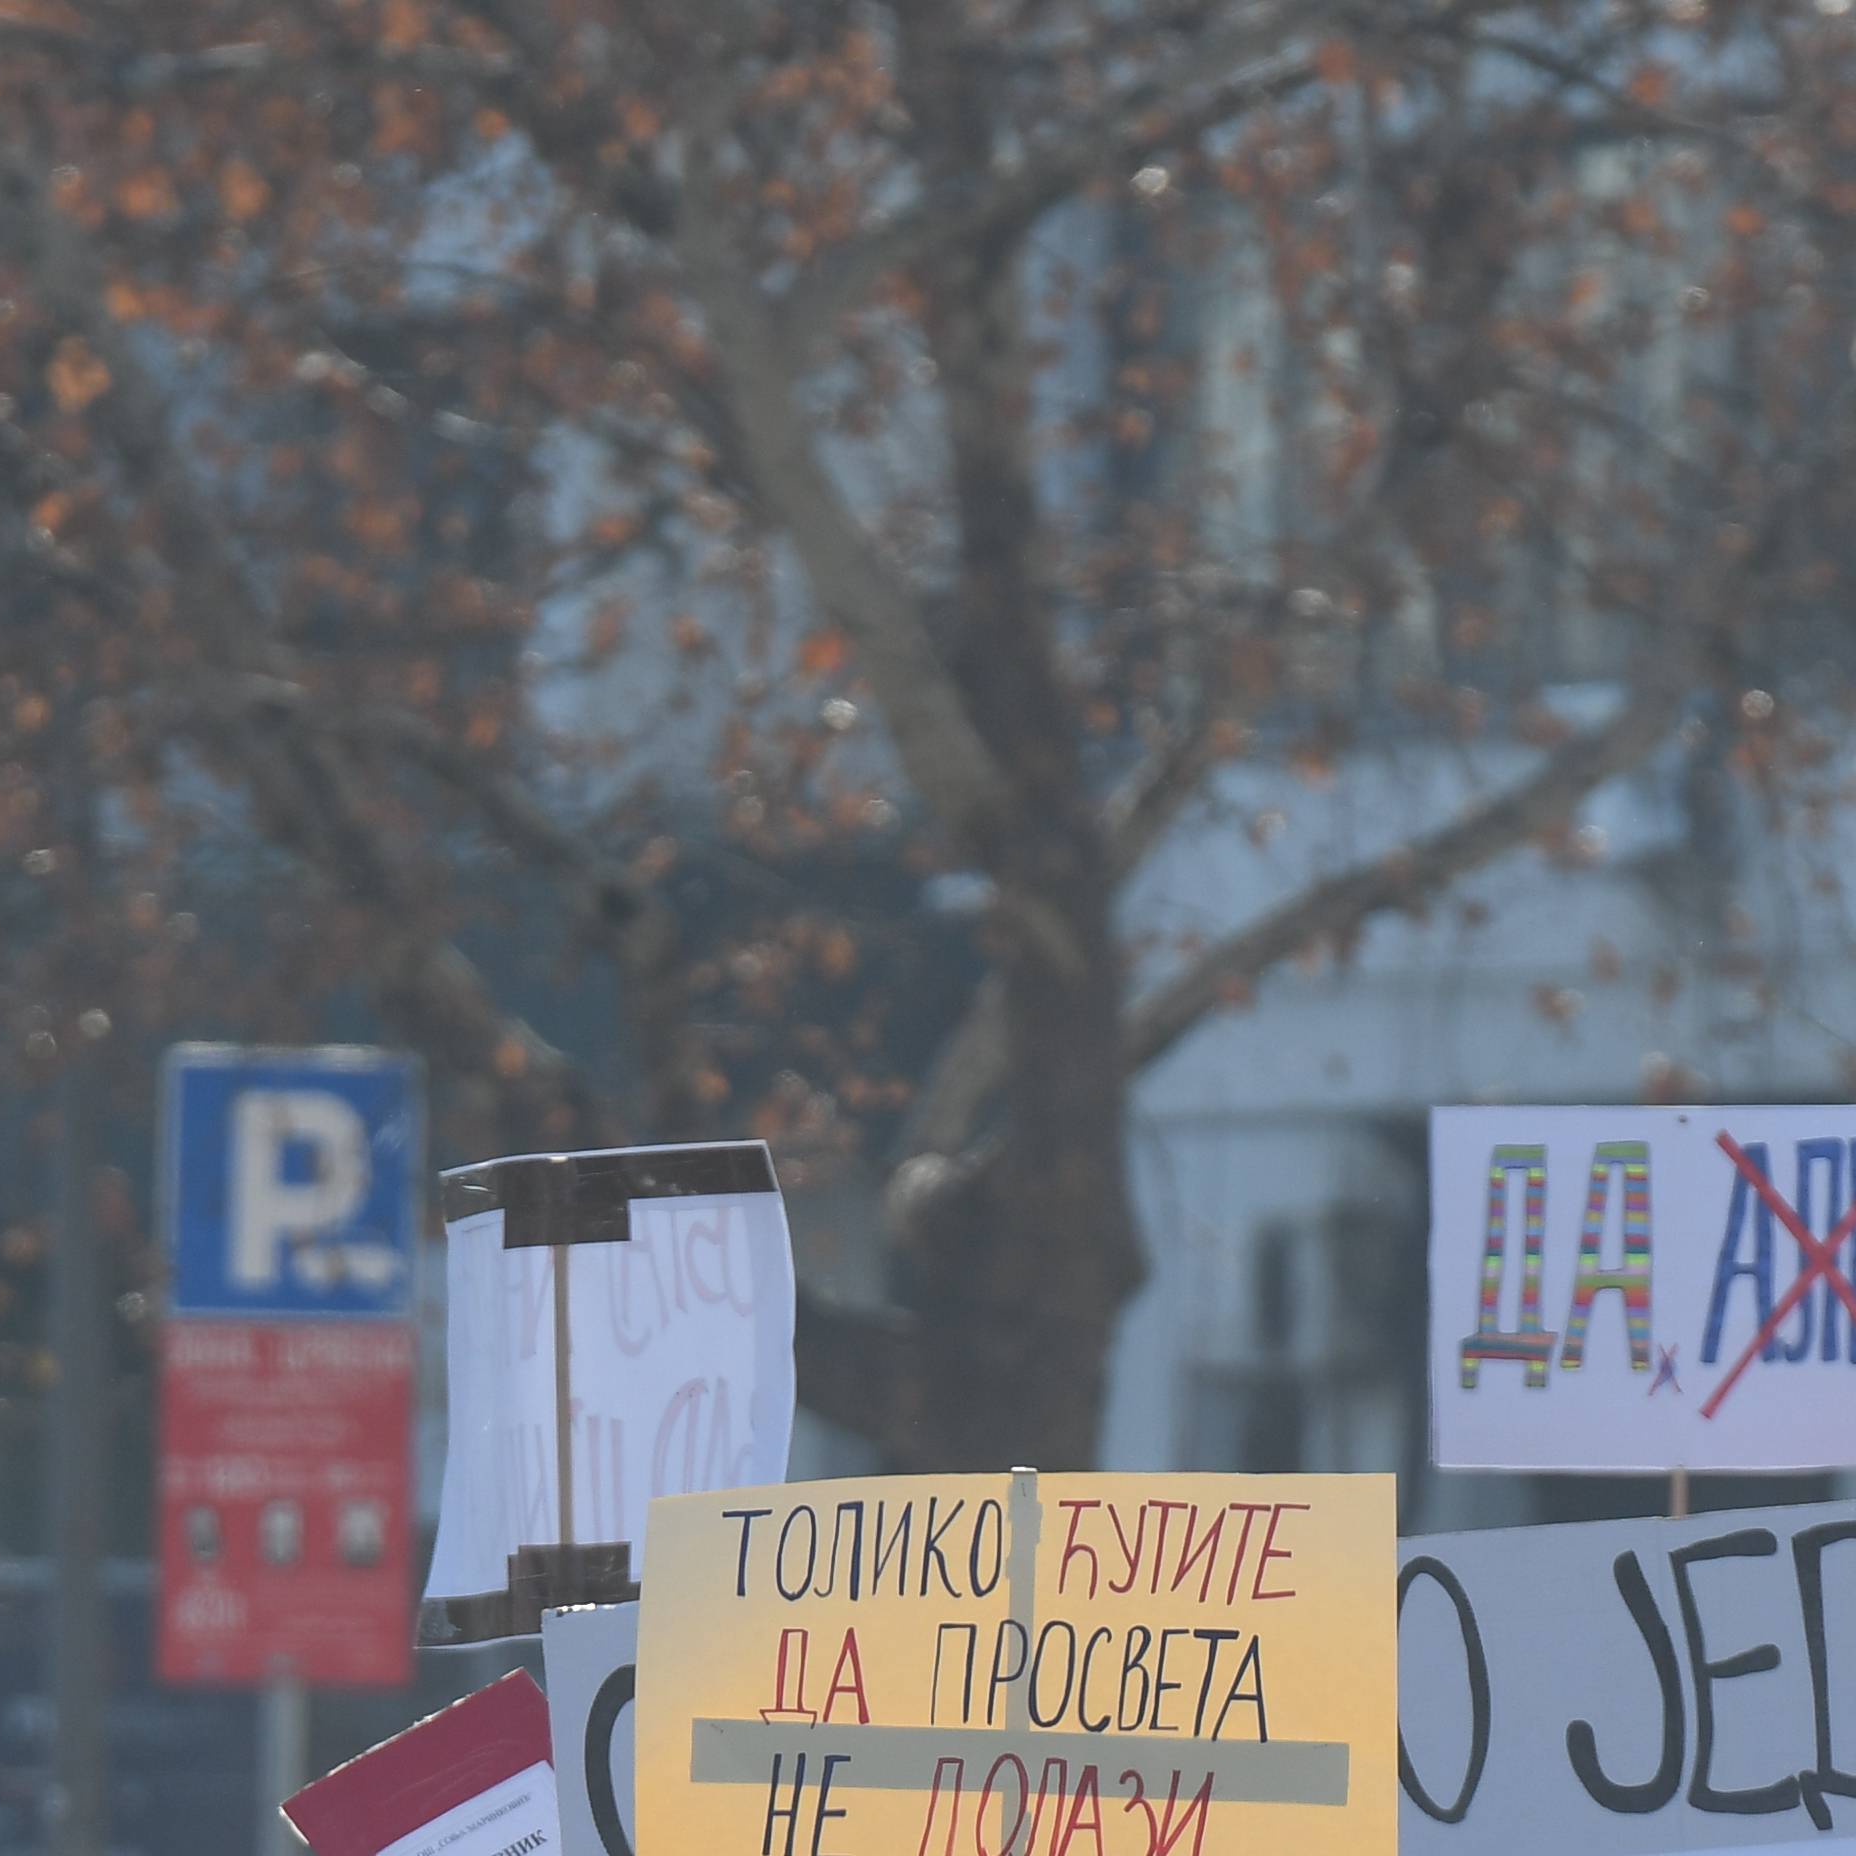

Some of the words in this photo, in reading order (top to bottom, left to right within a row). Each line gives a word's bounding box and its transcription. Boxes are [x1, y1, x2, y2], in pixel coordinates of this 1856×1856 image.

[228, 1088, 372, 1291] P
[722, 1497, 1004, 1602] ТОЛИКО
[1058, 1499, 1312, 1605] ЋУТИТЕ
[759, 1627, 871, 1729] ДА
[930, 1620, 1270, 1743] ПРОСВЕТА
